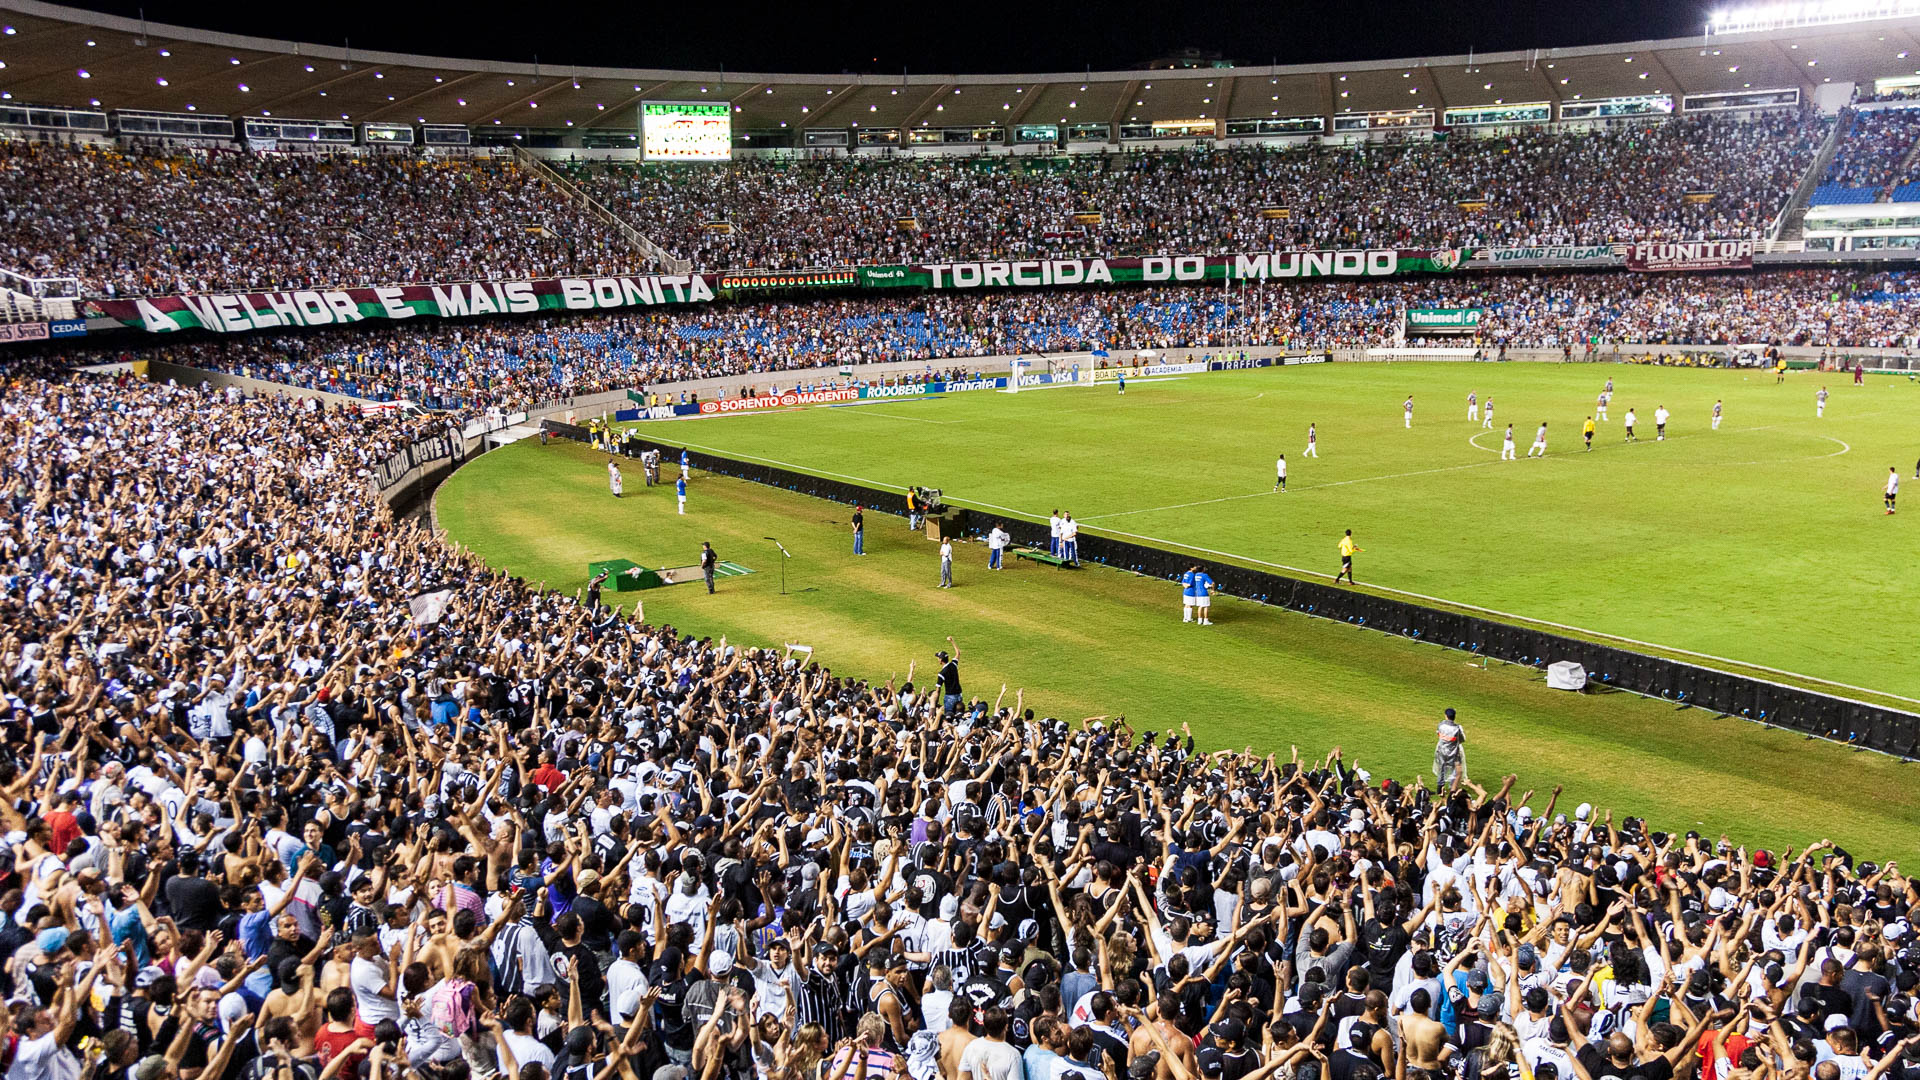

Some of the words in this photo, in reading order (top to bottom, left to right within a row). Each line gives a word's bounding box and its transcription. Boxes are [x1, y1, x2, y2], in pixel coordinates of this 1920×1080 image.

[1494, 248, 1544, 261] YOUNG
[1547, 247, 1573, 259] FLU
[1635, 241, 1752, 261] FLUNITOR
[922, 259, 1113, 288] TORCIDA
[1143, 256, 1205, 281] DO
[1235, 251, 1398, 279] MUNDO
[135, 299, 181, 333] A
[374, 287, 416, 319] E
[431, 282, 539, 318] MAIS
[560, 275, 716, 309] BONITA
[1411, 311, 1462, 323] Unimed
[52, 323, 87, 333] CEDAE
[1221, 359, 1262, 370] TRAFFIC
[1300, 354, 1326, 364] adidas
[1020, 375, 1041, 386] VISA
[1051, 372, 1073, 383] VISA
[867, 383, 926, 398] RODOBENS
[945, 378, 997, 393] Embratel
[797, 388, 859, 404] MAGENTIS
[720, 396, 779, 411] SORENTO
[647, 405, 677, 419] VIPAL
[411, 437, 443, 465] NOVE
